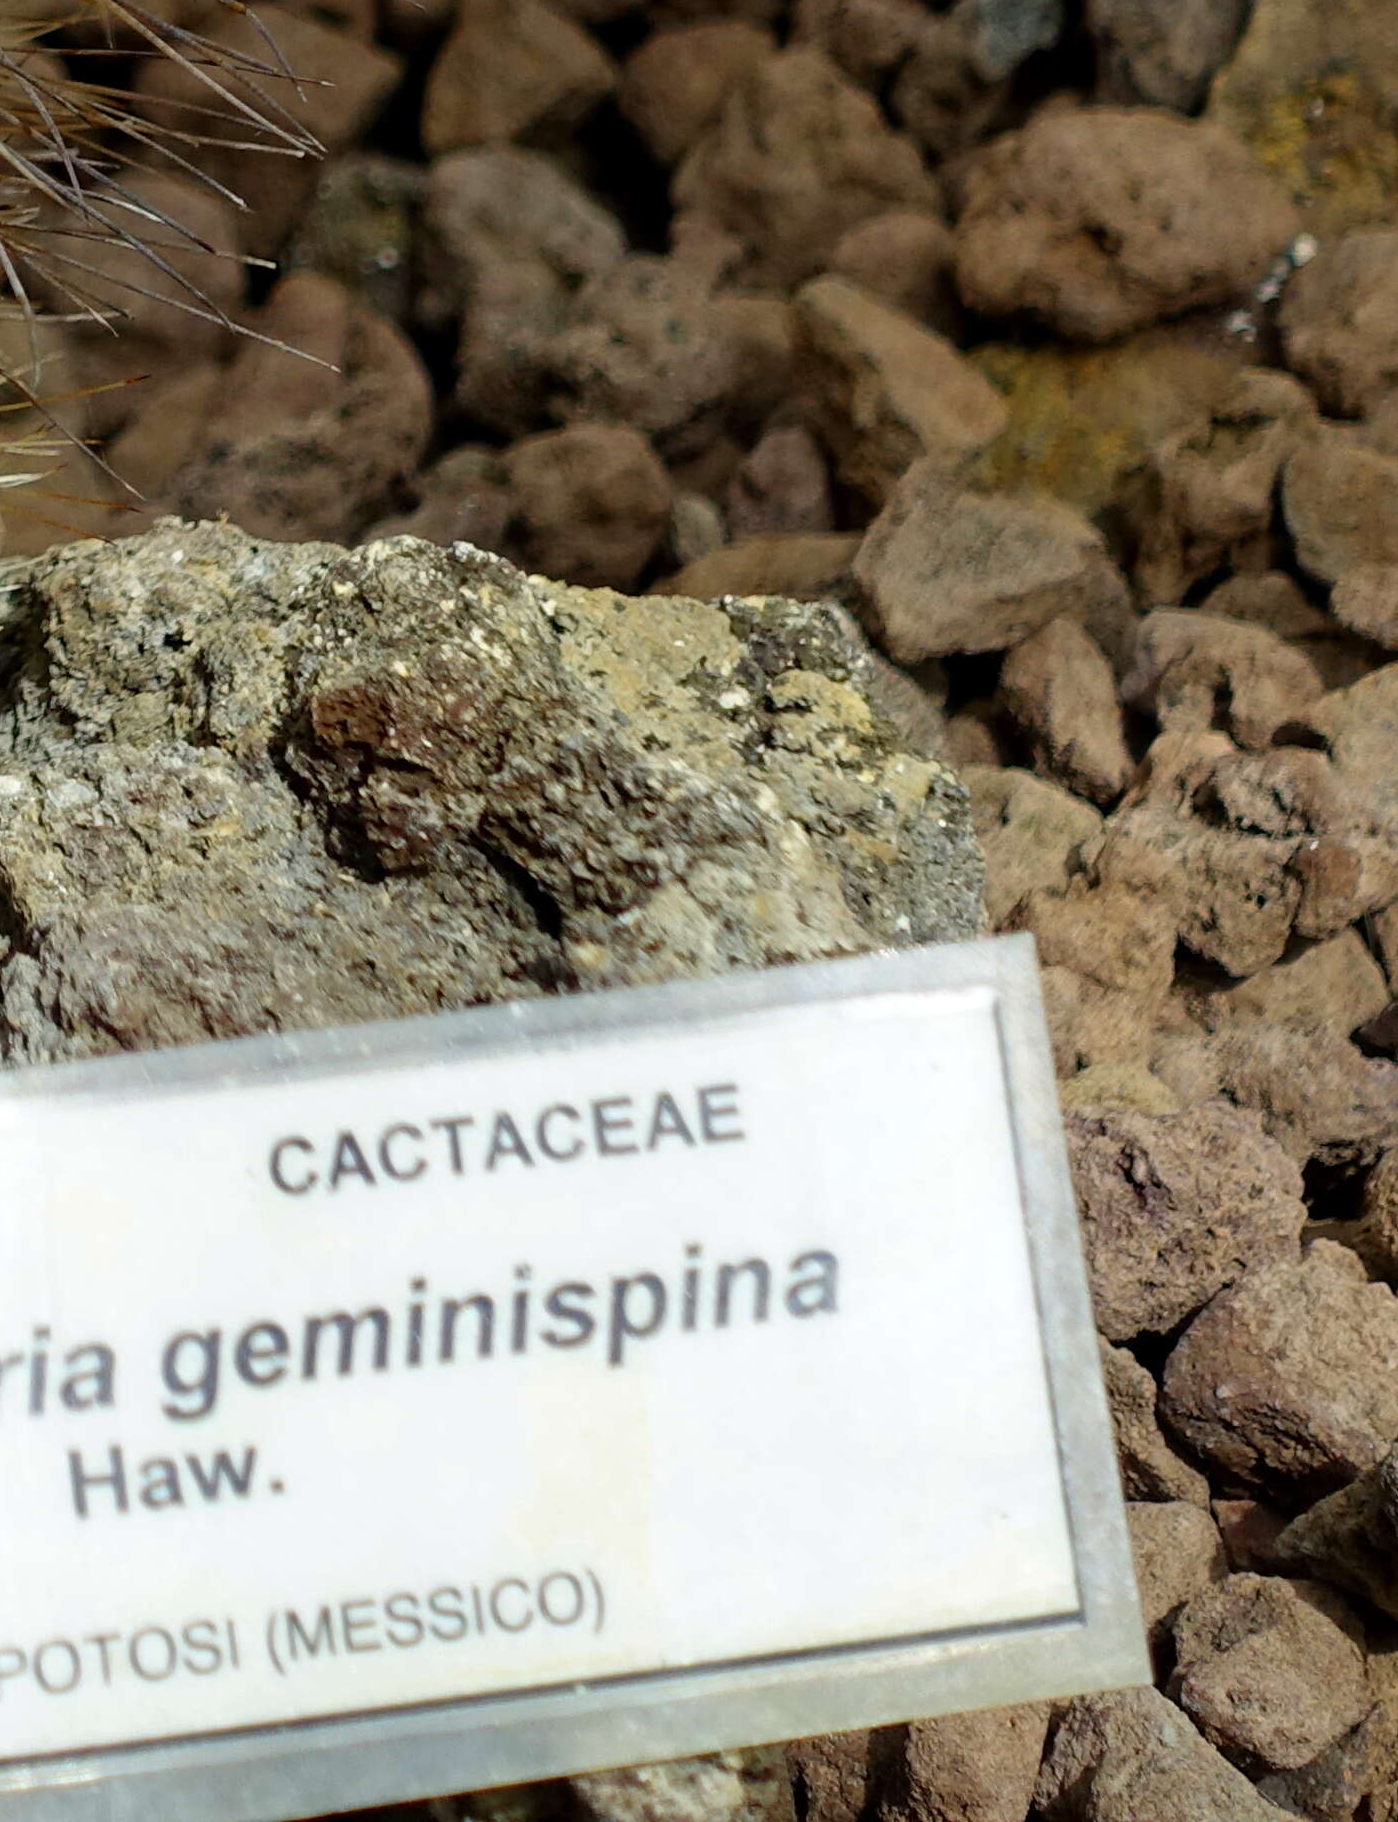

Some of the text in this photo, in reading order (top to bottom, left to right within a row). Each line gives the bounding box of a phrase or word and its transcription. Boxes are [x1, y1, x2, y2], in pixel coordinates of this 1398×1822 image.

[269, 1083, 747, 1197] CACTACEAE
[160, 1243, 841, 1423] geminispina
[67, 1444, 286, 1519] Haw.
[265, 1567, 609, 1675] (MESSICO)
